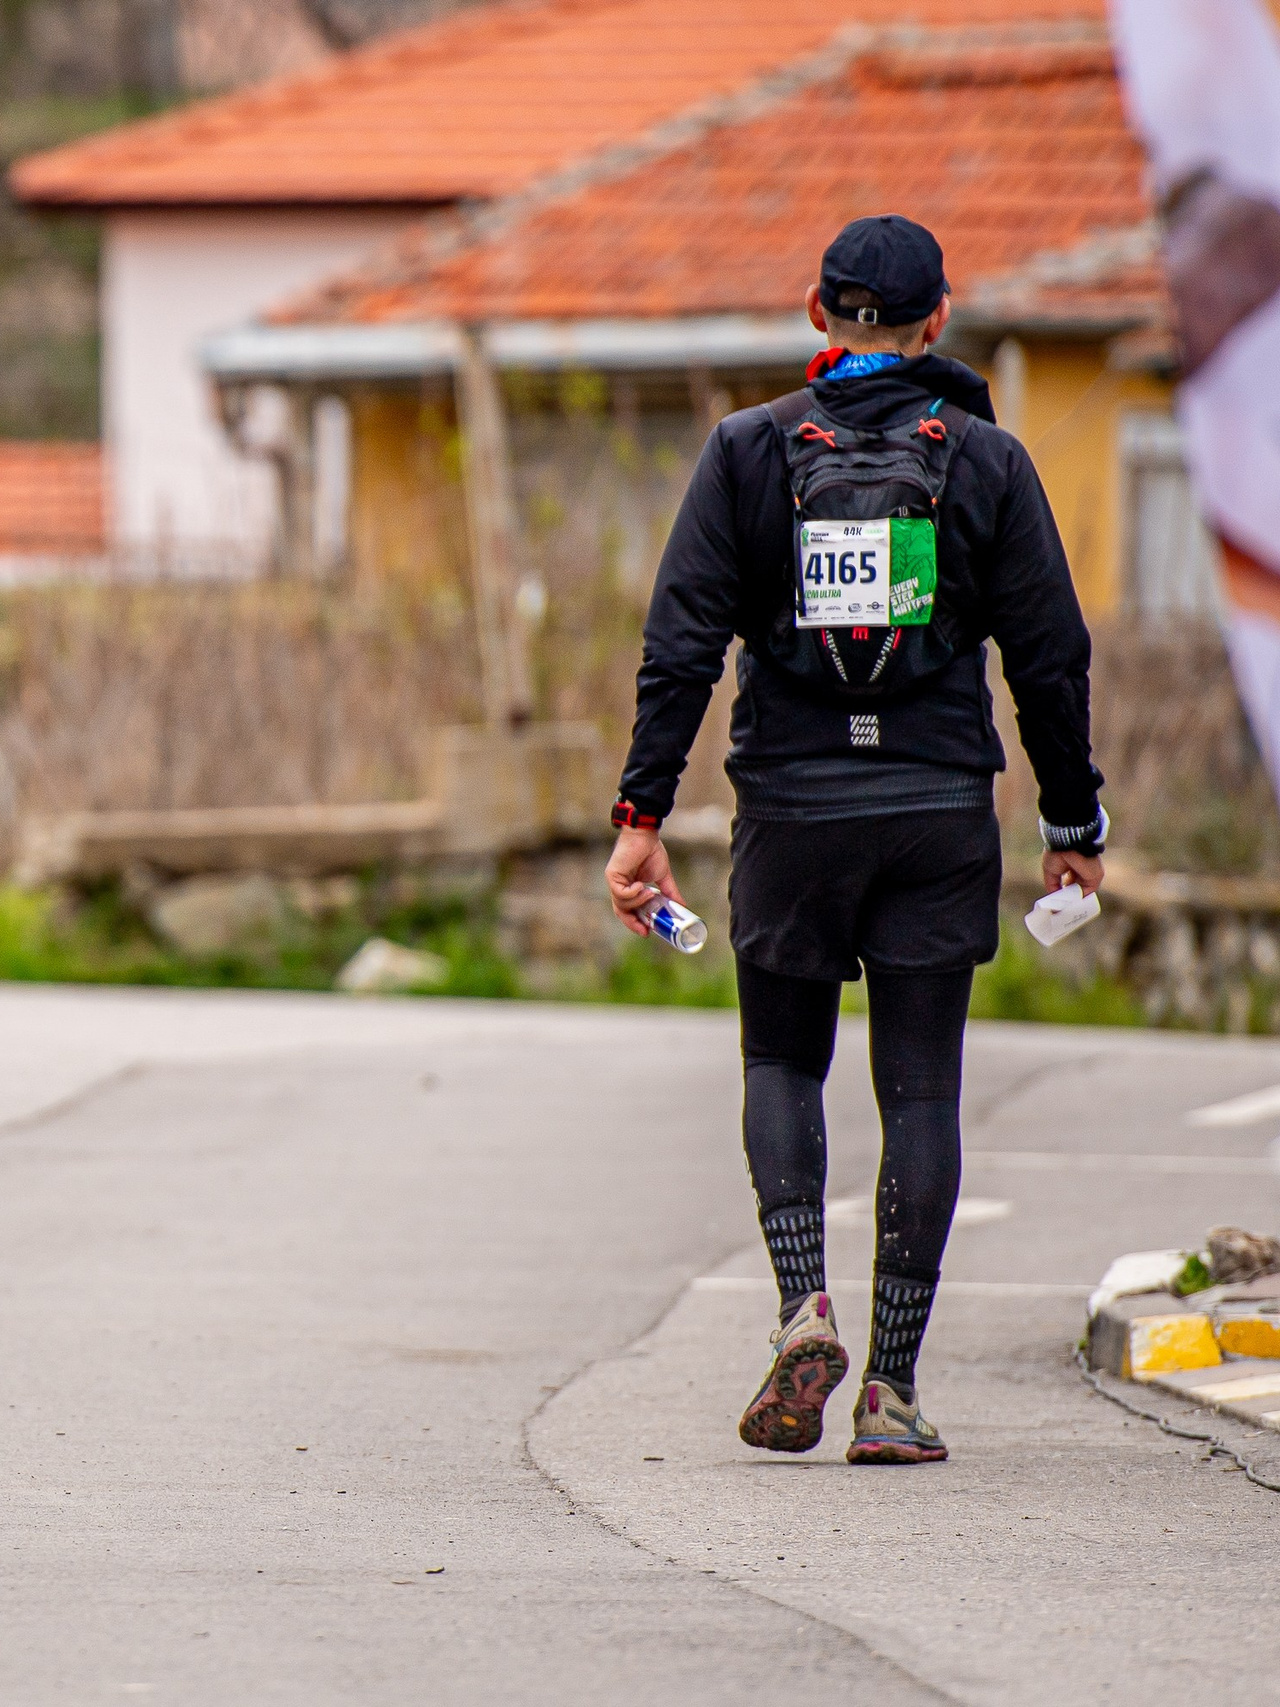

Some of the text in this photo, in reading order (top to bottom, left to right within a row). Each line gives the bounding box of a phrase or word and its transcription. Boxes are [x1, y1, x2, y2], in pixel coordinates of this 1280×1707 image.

[804, 550, 877, 585] 4165
[820, 589, 842, 599] ULTRA
[890, 590, 914, 606] STEP
